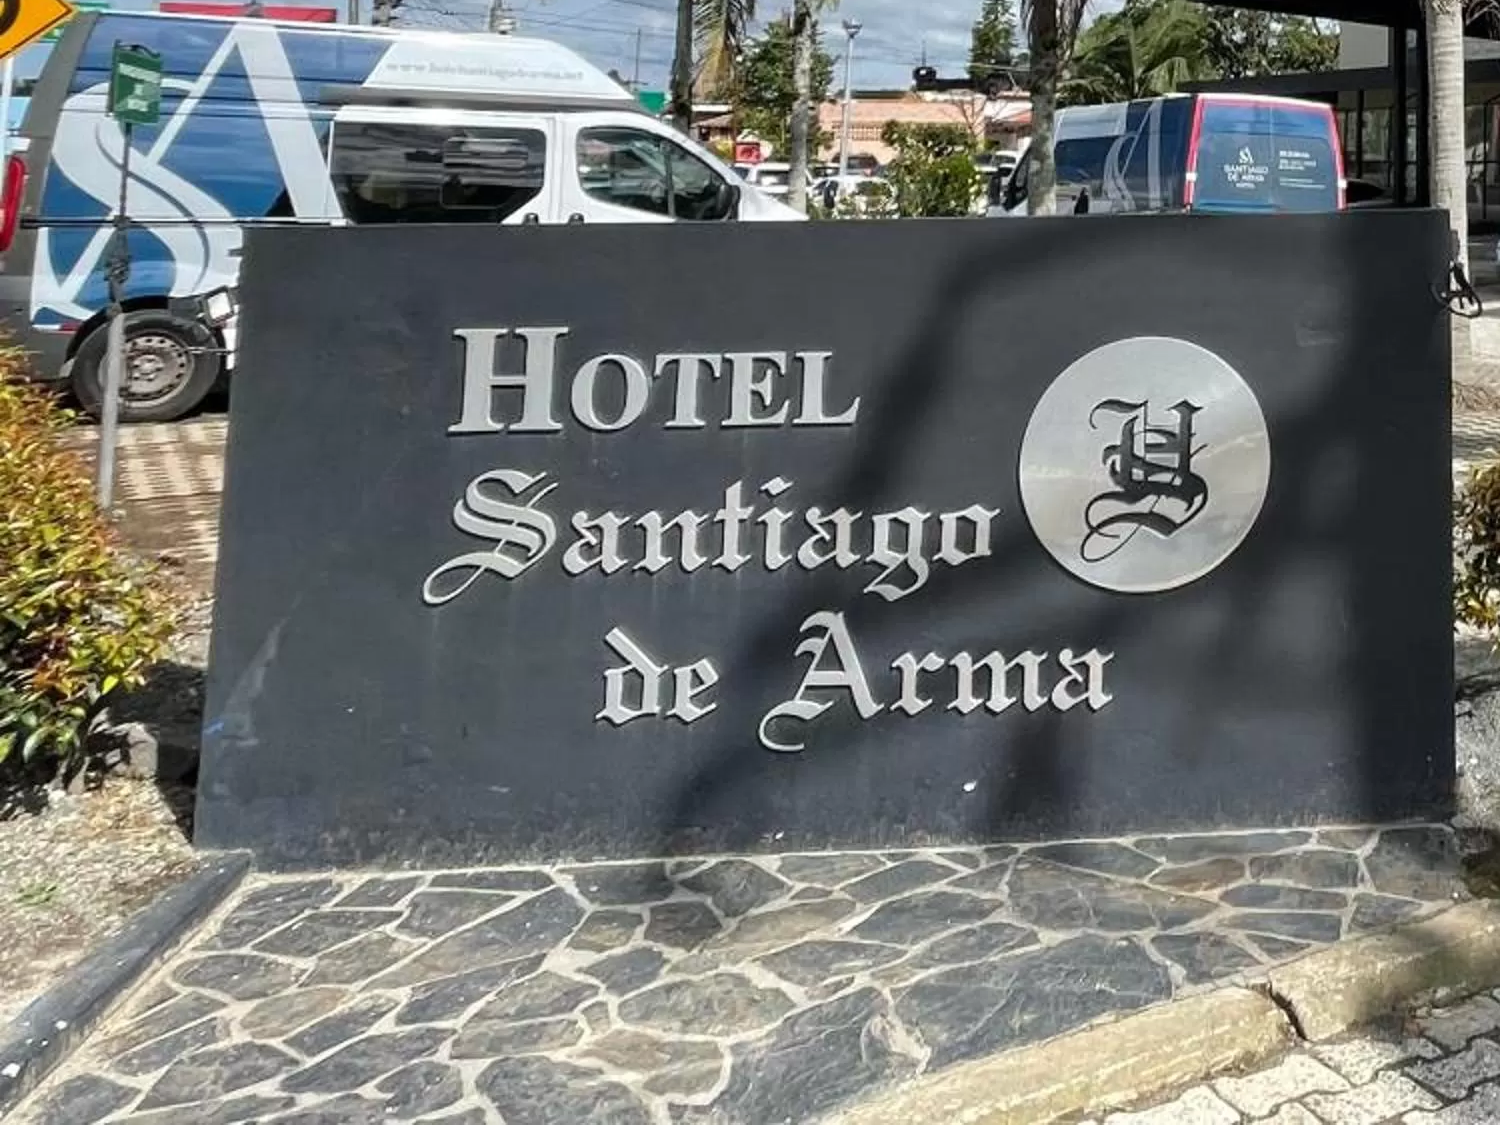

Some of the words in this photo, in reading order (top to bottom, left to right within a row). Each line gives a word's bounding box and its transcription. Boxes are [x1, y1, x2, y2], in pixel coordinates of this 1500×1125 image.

[447, 326, 861, 434] HOTEL
[422, 469, 1000, 605] Santiago
[595, 626, 720, 726] de
[758, 610, 1115, 753] Arma
